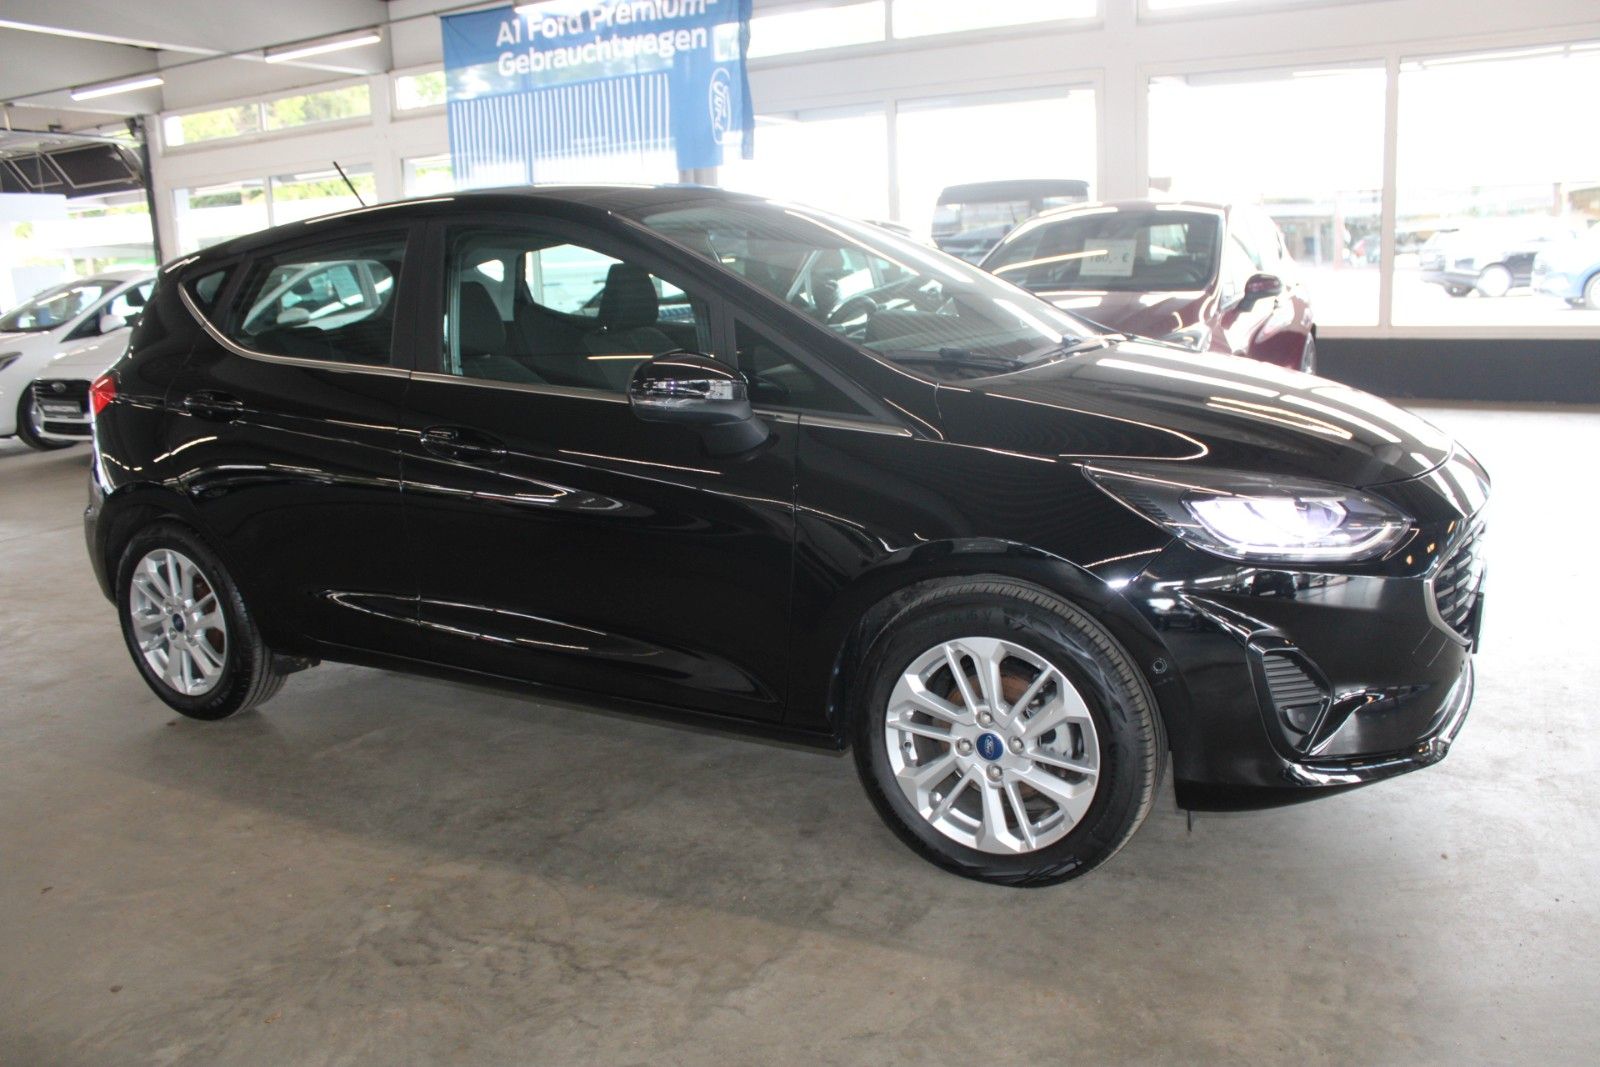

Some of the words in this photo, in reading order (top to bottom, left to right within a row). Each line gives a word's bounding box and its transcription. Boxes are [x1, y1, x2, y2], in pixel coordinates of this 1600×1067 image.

[498, 27, 707, 77] Gebrauchtwagen
[527, 12, 584, 42] Ford
[712, 80, 729, 132] Ford
